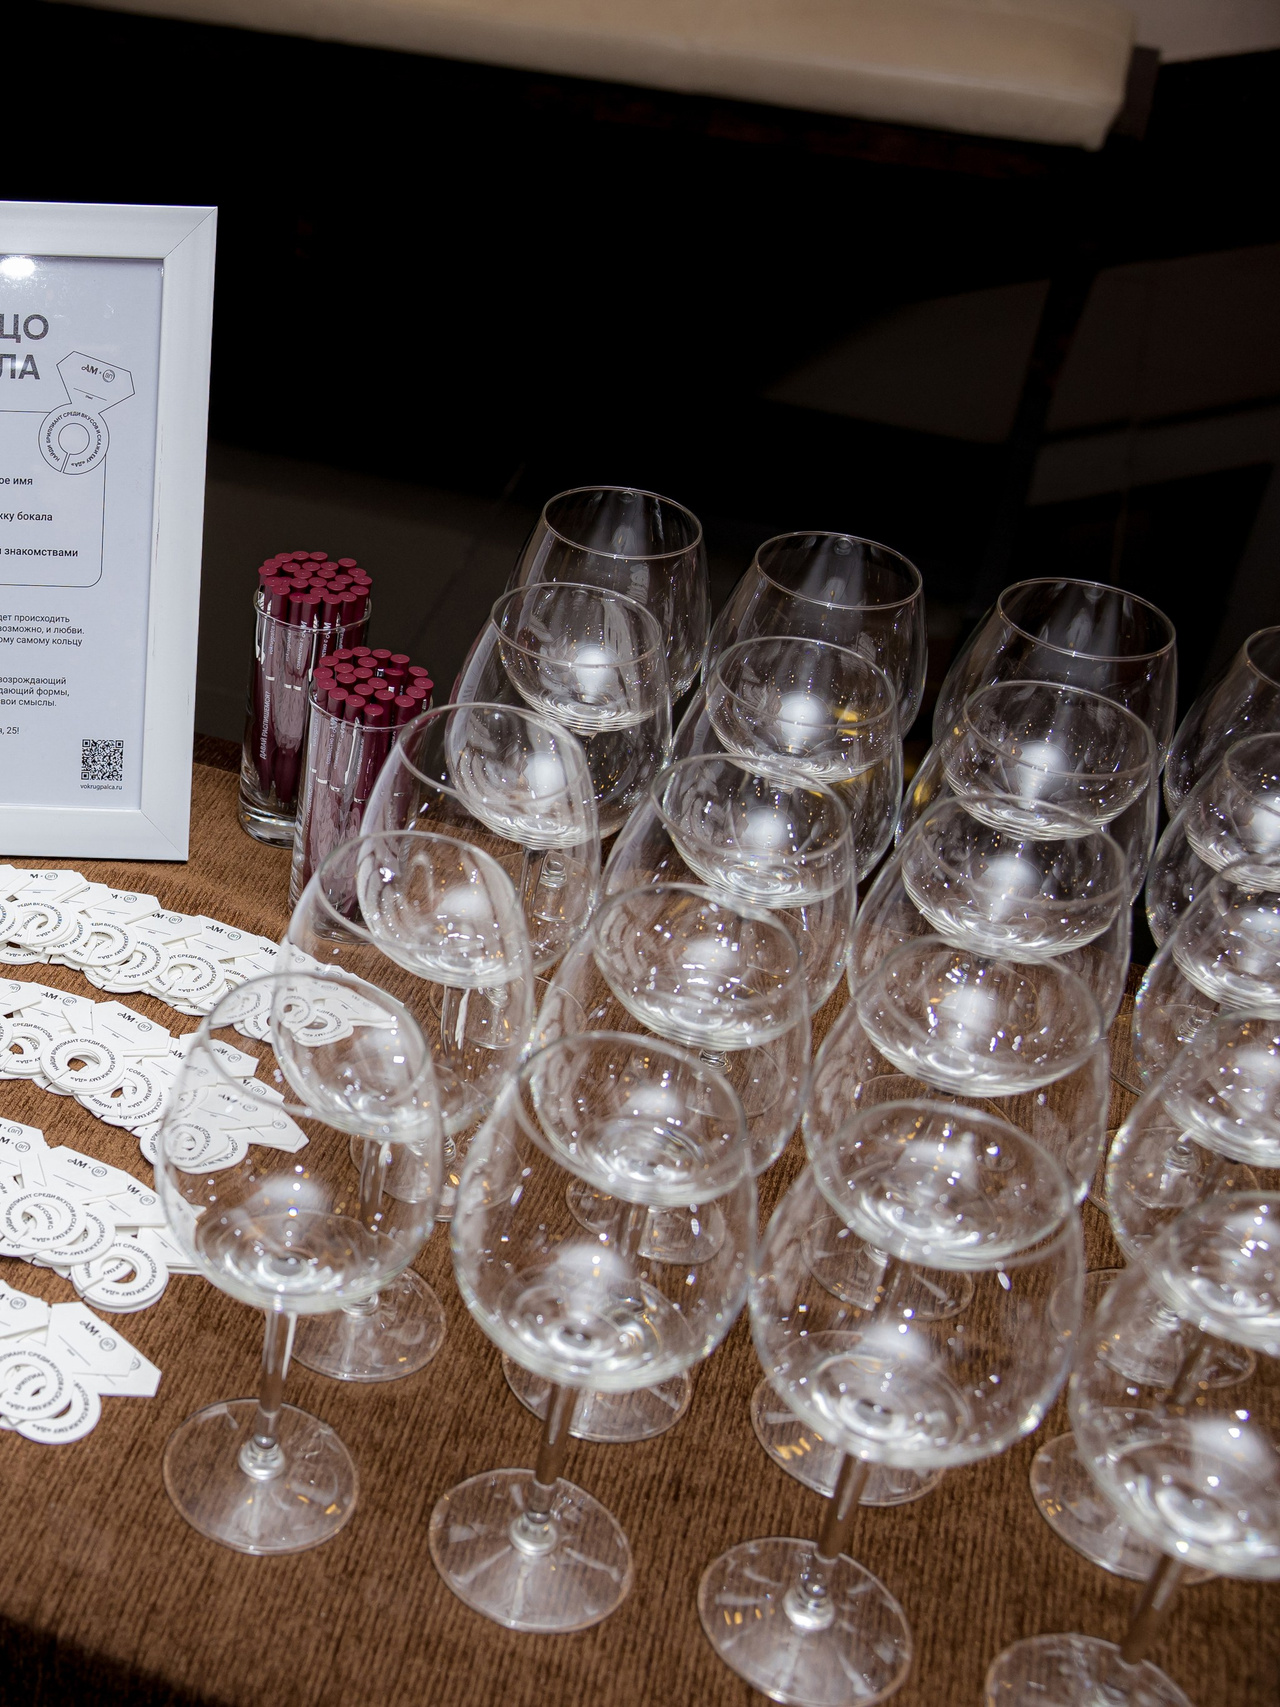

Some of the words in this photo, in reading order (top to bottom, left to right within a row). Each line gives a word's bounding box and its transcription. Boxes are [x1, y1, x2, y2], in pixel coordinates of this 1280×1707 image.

[81, 413, 100, 430] ВКУСОВ
[46, 415, 64, 444] БРИЛЛИАНТ
[47, 445, 61, 463] НАЙДИ
[86, 454, 97, 464] ЕМУ
[71, 460, 87, 468] «ДА»
[13, 478, 33, 486] имя
[17, 511, 53, 522] бокала
[4, 548, 78, 557] знакомствами
[14, 614, 71, 624] происходить
[53, 625, 85, 635] любви.
[16, 637, 50, 647] самому
[52, 638, 83, 648] кольцу
[36, 687, 70, 697] формы,
[18, 699, 57, 707] смыслы.
[6, 726, 20, 735] 25!
[80, 783, 123, 791] vokrugpalca.ru
